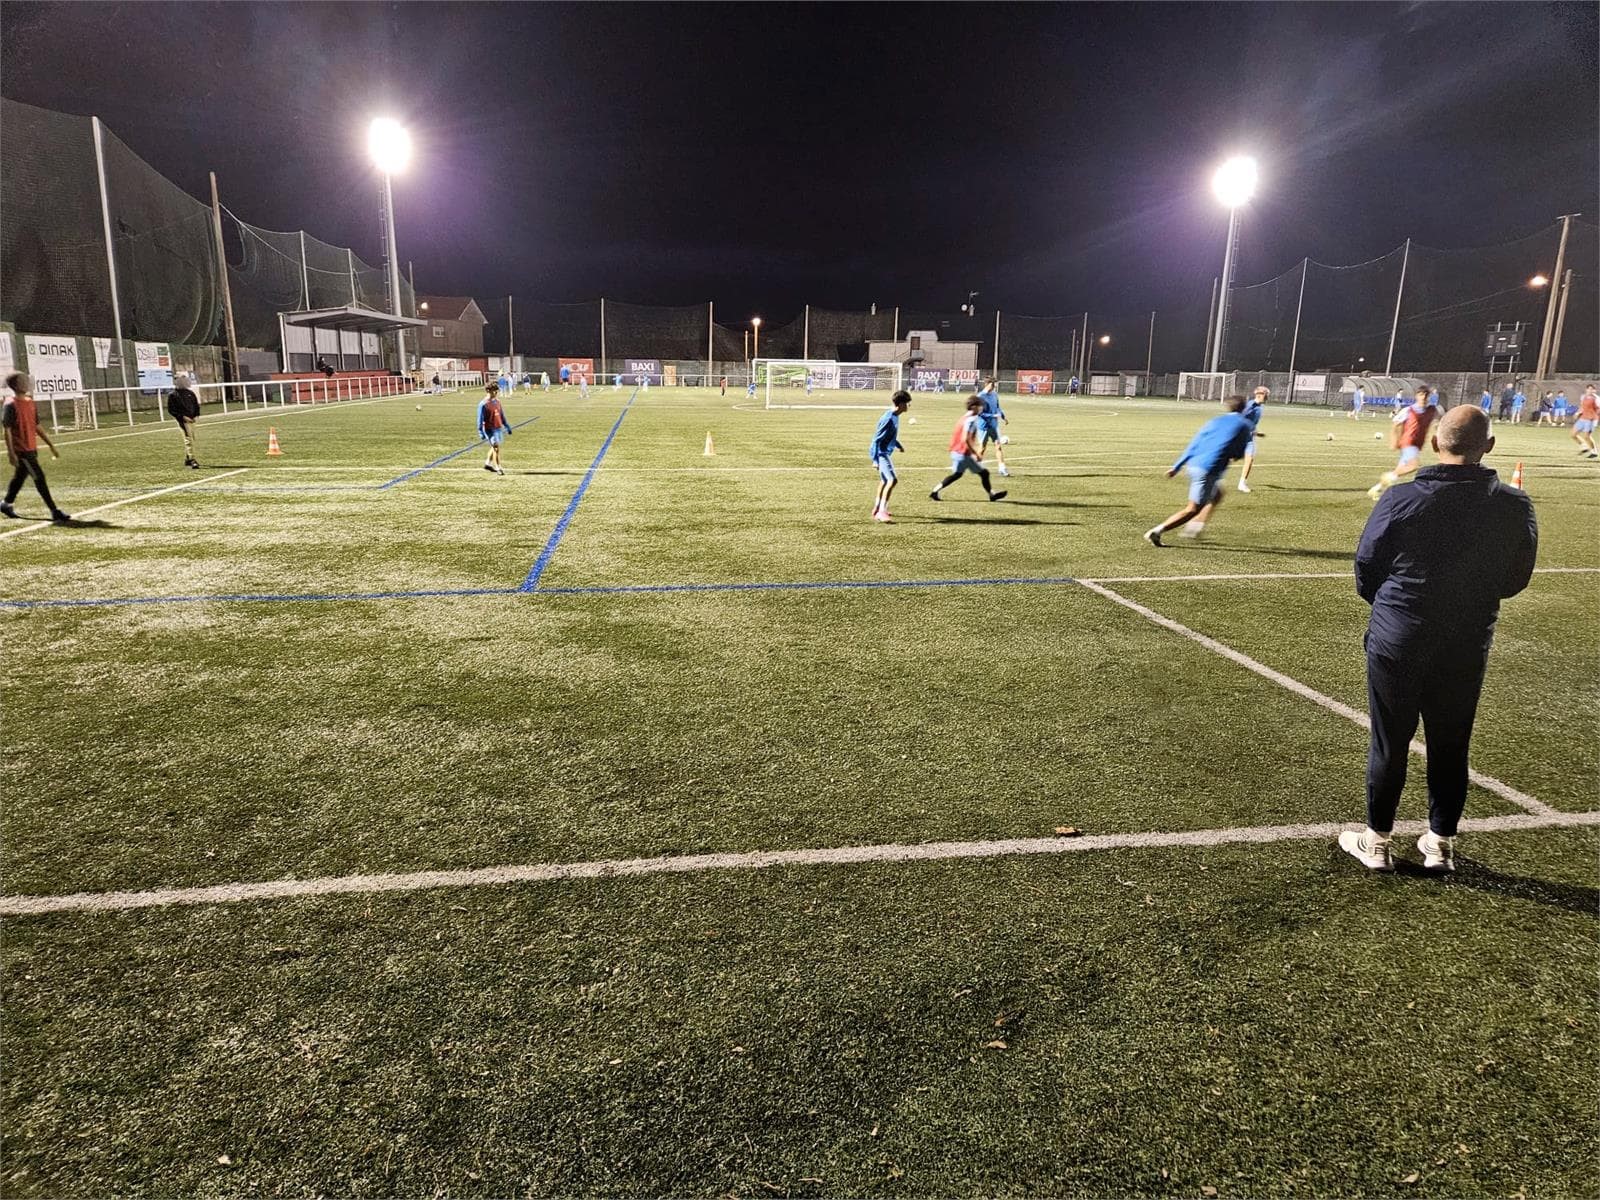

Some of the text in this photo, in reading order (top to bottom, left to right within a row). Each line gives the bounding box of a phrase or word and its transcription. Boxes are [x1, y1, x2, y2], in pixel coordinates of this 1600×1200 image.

[39, 343, 74, 356] DINAK
[631, 362, 655, 371] BAXI
[36, 374, 78, 393] resideo
